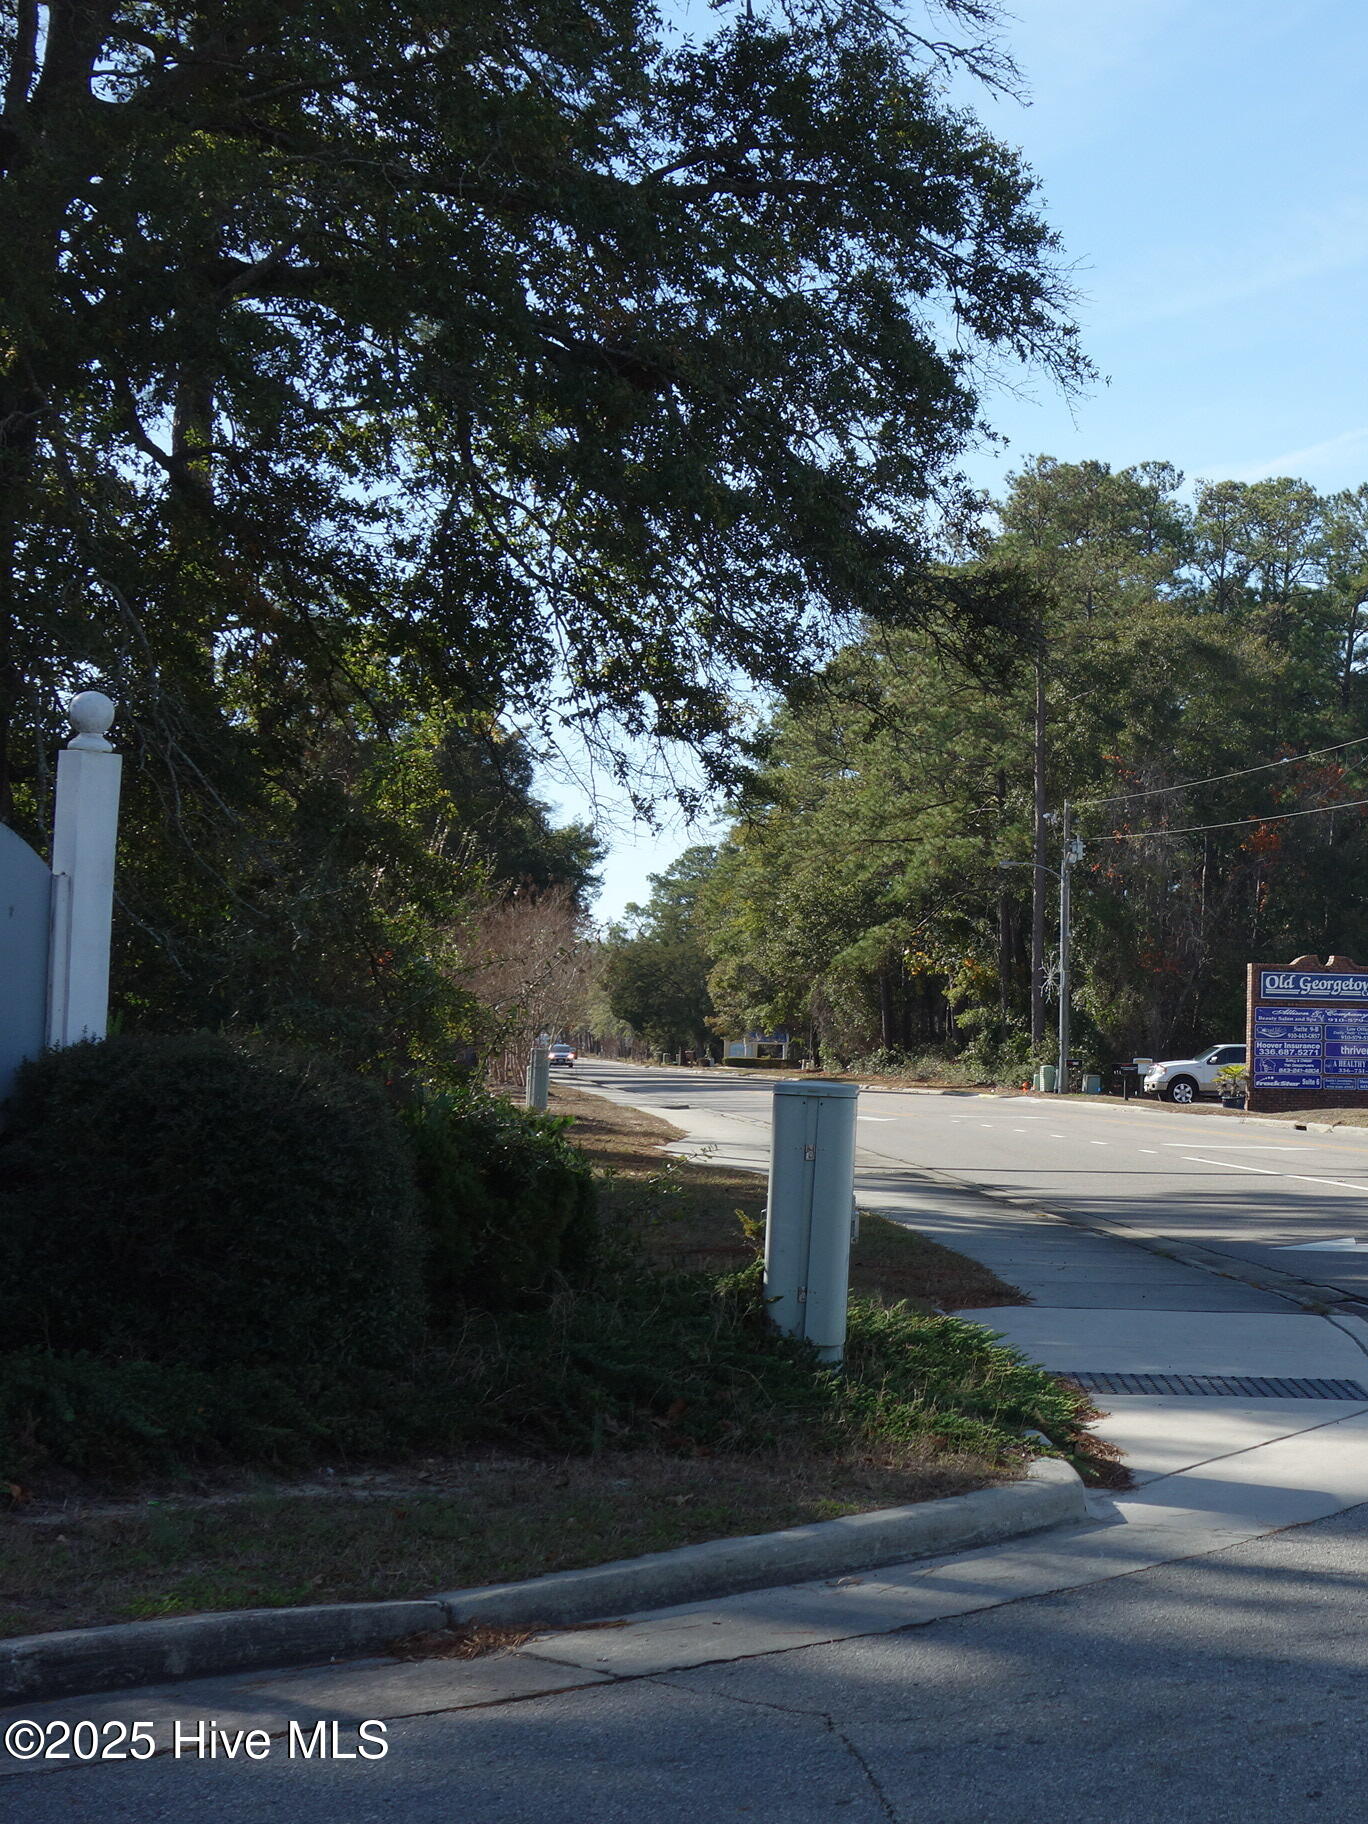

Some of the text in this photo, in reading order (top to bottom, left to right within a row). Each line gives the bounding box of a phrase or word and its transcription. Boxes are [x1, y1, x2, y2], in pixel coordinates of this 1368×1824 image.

[1266, 975, 1296, 989] Old
[1325, 1008, 1368, 1019] Company
[1284, 1042, 1320, 1050] Insurance
[1339, 1060, 1366, 1068] HEALTHY
